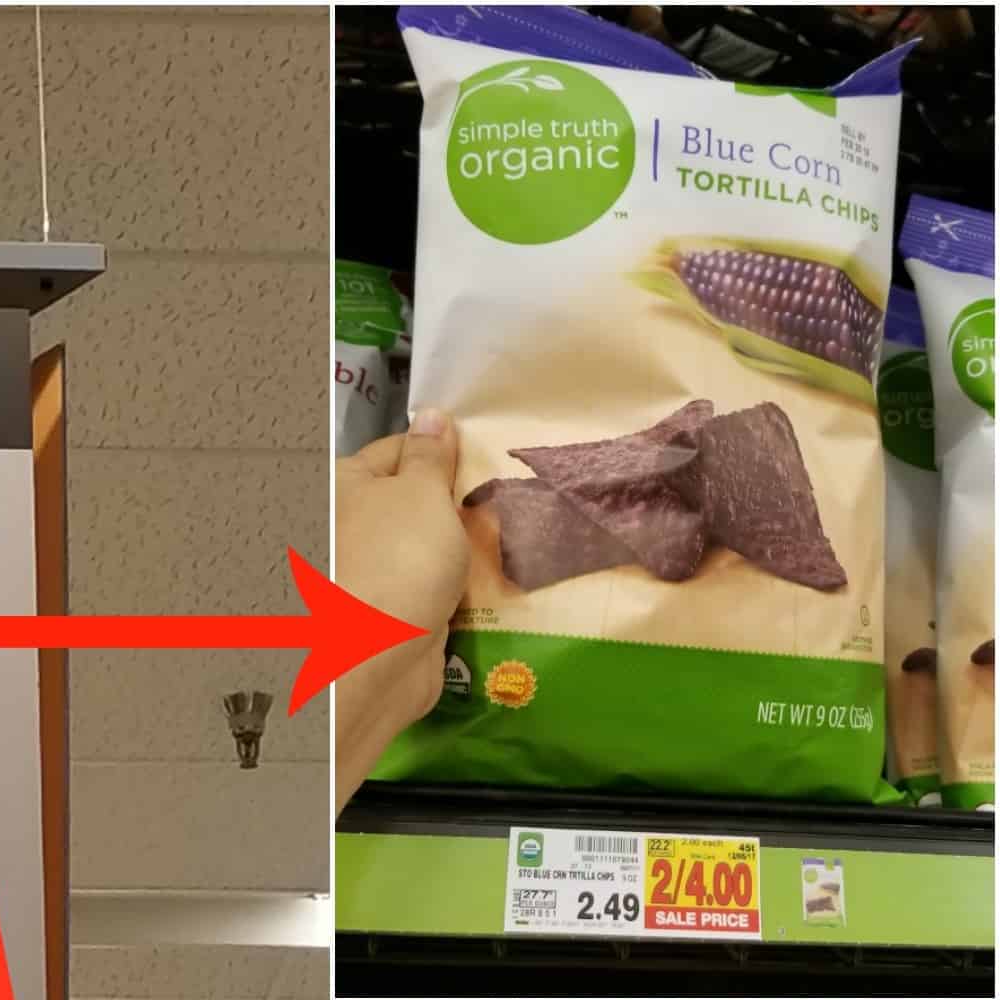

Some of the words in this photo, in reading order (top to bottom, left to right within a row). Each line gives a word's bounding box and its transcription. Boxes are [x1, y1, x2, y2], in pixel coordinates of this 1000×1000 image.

[458, 119, 541, 143] simple
[550, 118, 619, 138] truth
[460, 142, 620, 181] organic
[681, 125, 754, 164] Blue
[768, 141, 841, 187] Corn
[676, 167, 812, 209] TORTILLA
[820, 194, 880, 233] CHIPS
[757, 701, 786, 724] NET
[790, 704, 814, 726] WT
[816, 705, 825, 727] 9
[829, 706, 847, 728] OZ
[534, 870, 550, 879] BLUE
[651, 859, 752, 907] 2/4.00
[577, 891, 640, 922] 2.49
[656, 911, 696, 925] SALE
[701, 913, 749, 928] PRICE
